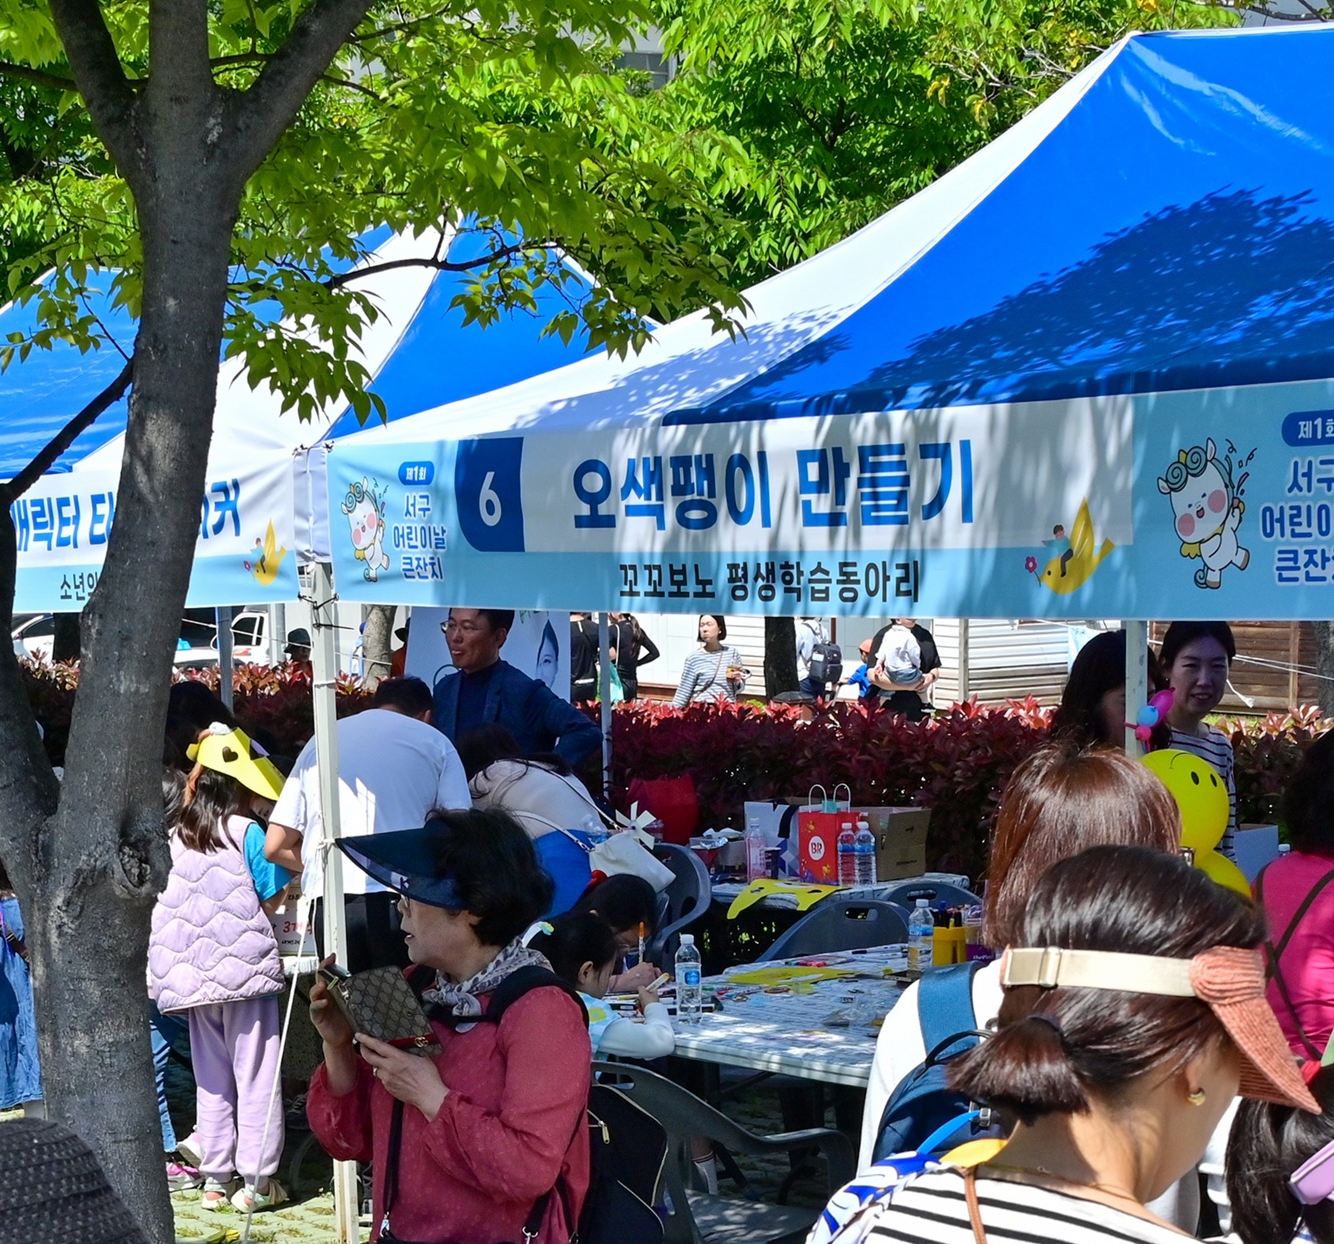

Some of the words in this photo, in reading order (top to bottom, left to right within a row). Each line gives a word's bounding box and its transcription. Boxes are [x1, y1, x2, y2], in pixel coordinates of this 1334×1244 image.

[405, 465, 427, 481] 제1회
[572, 452, 773, 531] 오색팽이
[796, 439, 975, 528] 만들기
[404, 494, 431, 519] 서구
[479, 471, 502, 526] 6
[392, 525, 447, 551] 어린이날
[401, 556, 444, 581] 큰잔치
[618, 561, 716, 600] 꼬꼬보노
[726, 559, 921, 604] 평생학습동아리
[811, 842, 823, 855] BR
